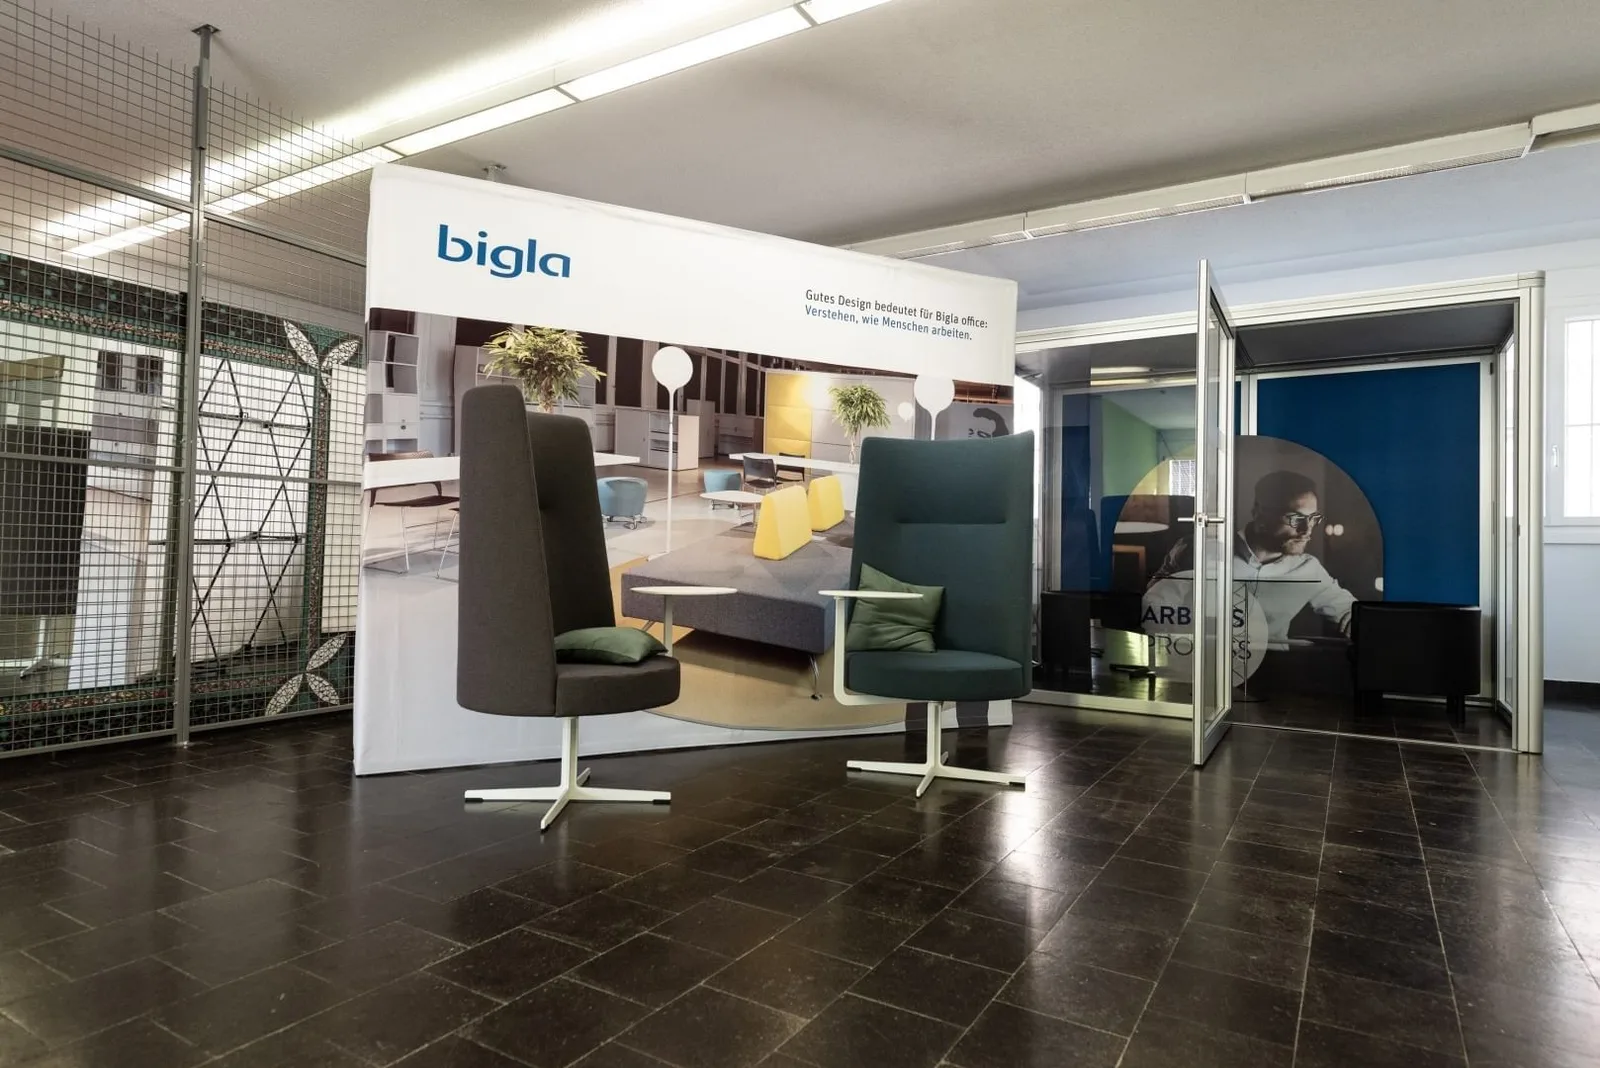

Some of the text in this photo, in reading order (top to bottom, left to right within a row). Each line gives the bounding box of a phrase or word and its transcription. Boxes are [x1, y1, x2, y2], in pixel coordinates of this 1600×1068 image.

[438, 223, 571, 278] bigla
[805, 289, 988, 328] Gutes Design bedeutet für Bigla office:
[805, 304, 972, 340] Verstehen, wie Menschen arbeiten.
[1141, 605, 1245, 628] ARBS
